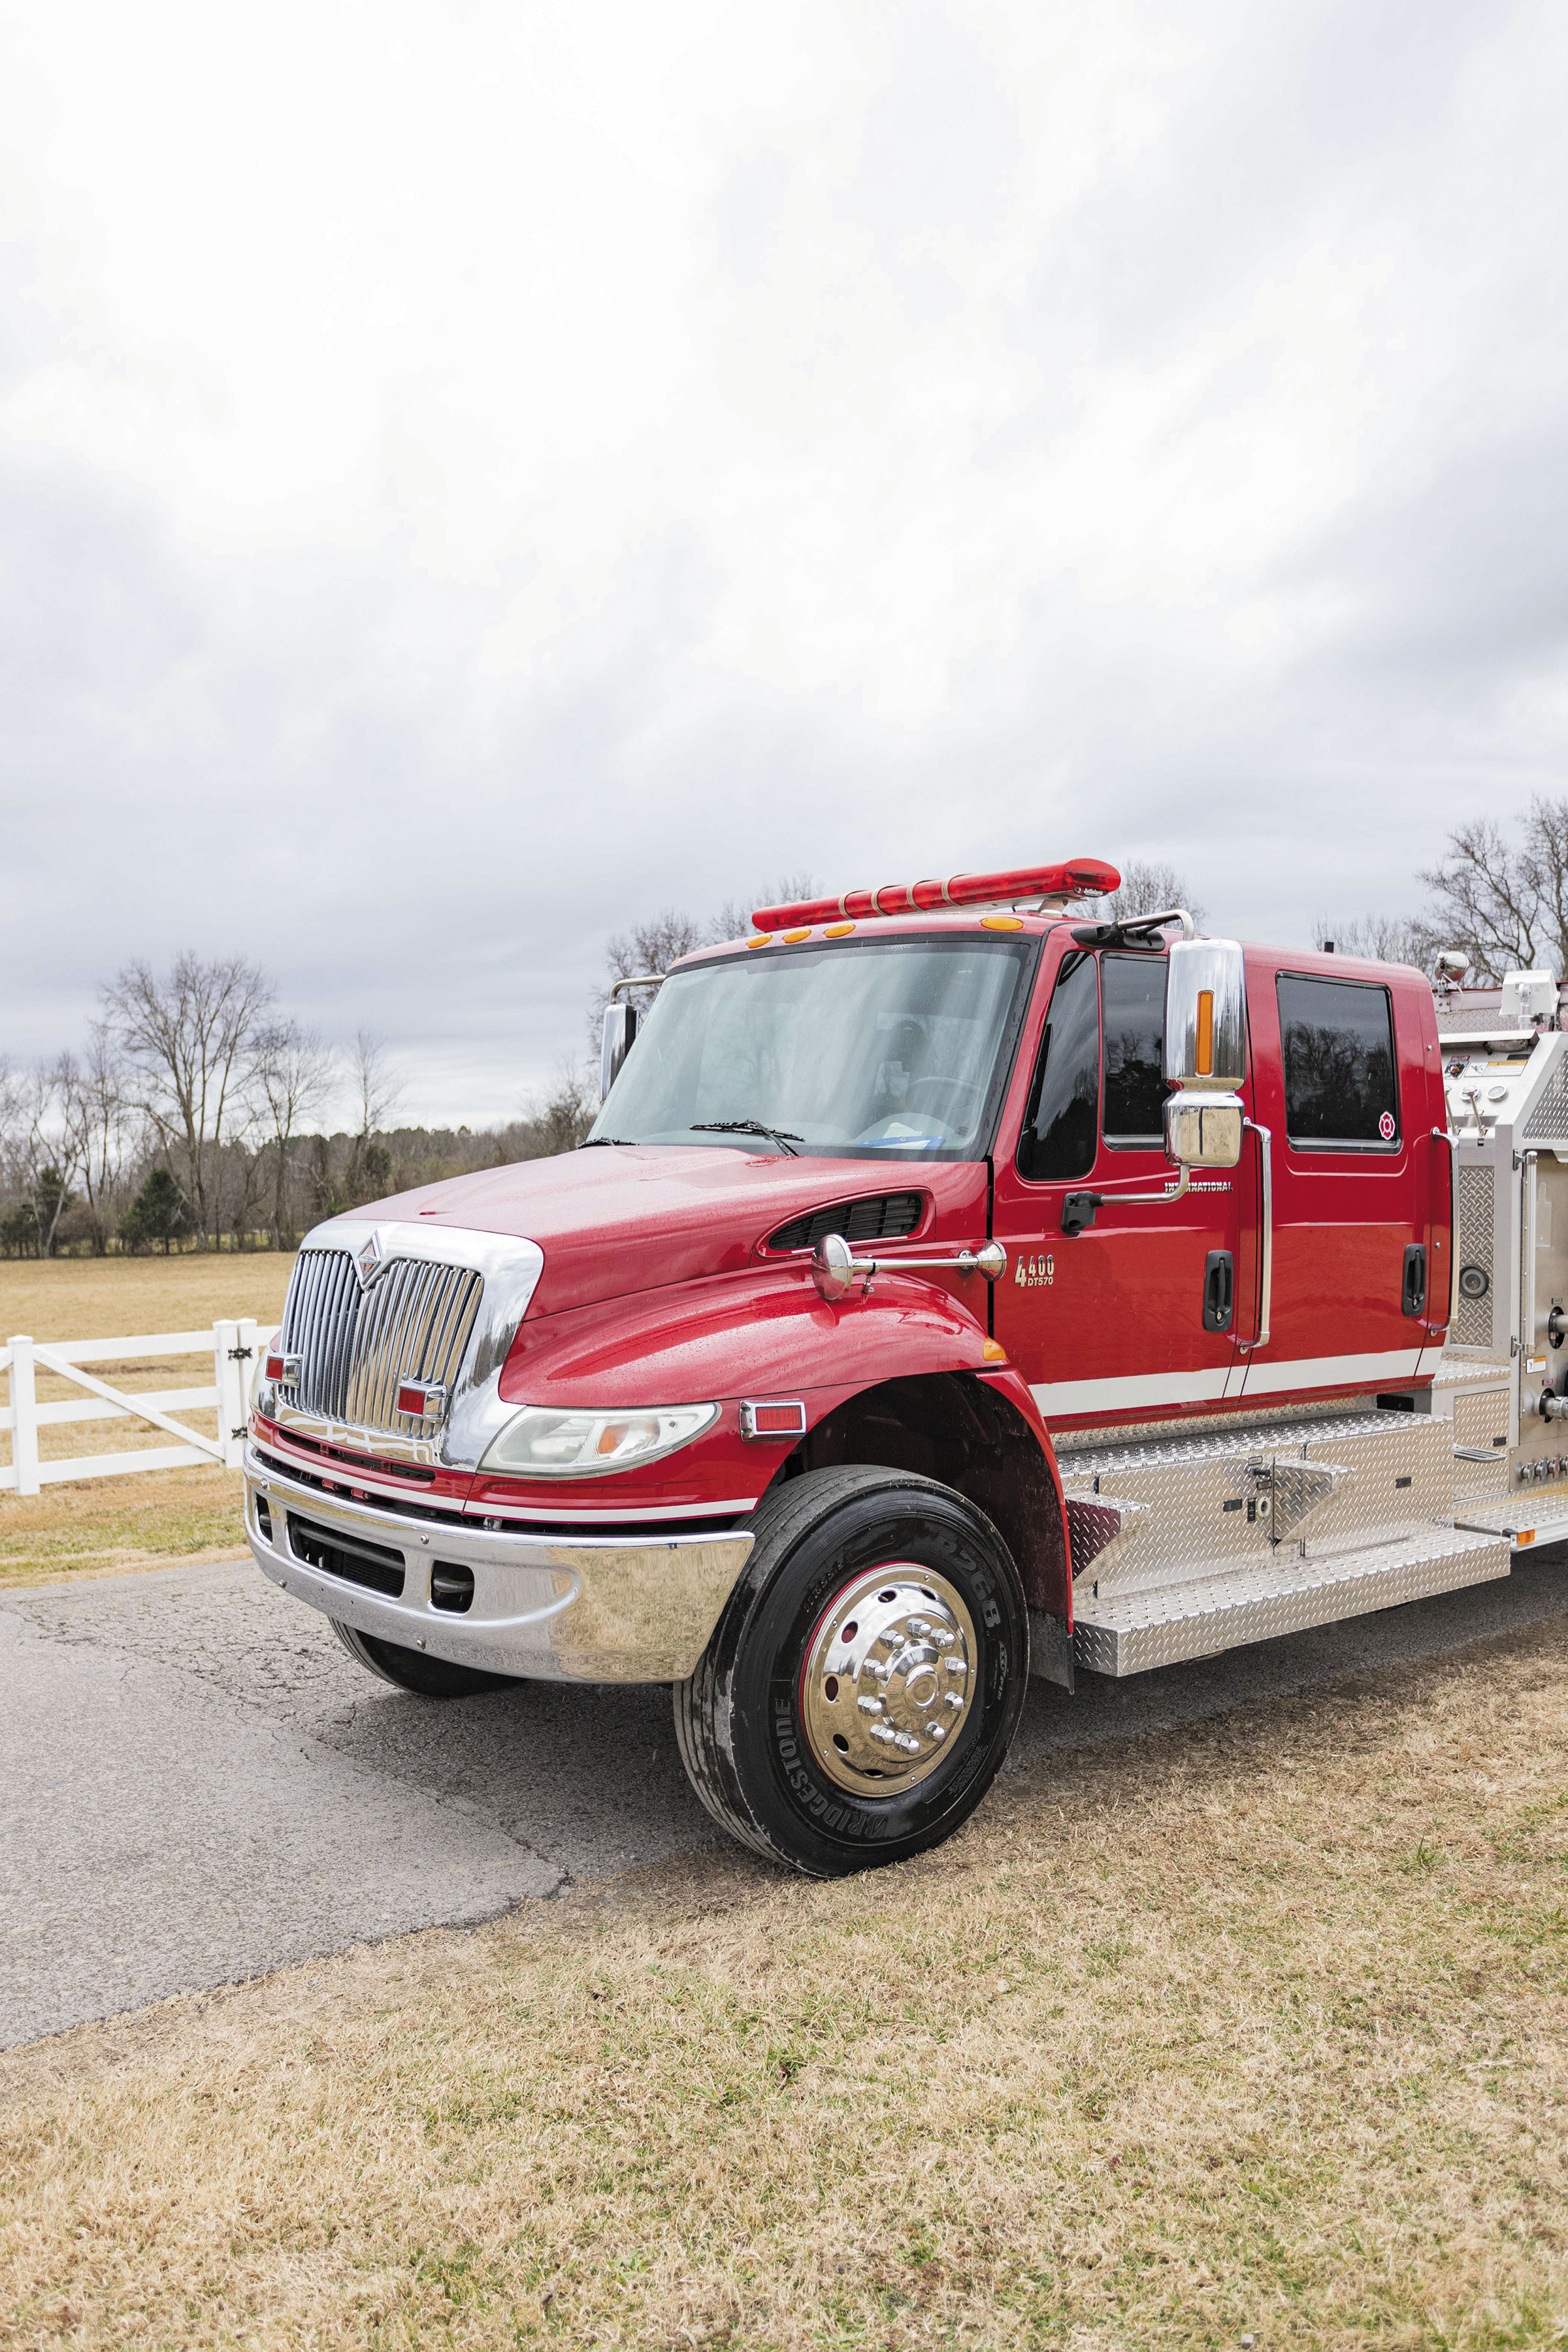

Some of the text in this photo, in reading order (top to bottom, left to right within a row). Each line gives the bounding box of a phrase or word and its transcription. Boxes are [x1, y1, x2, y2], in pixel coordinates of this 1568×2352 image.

[1015, 1254, 1054, 1288] 4400
[1028, 1276, 1053, 1286] DT570
[774, 1698, 888, 1838] BRIDGESTONE
